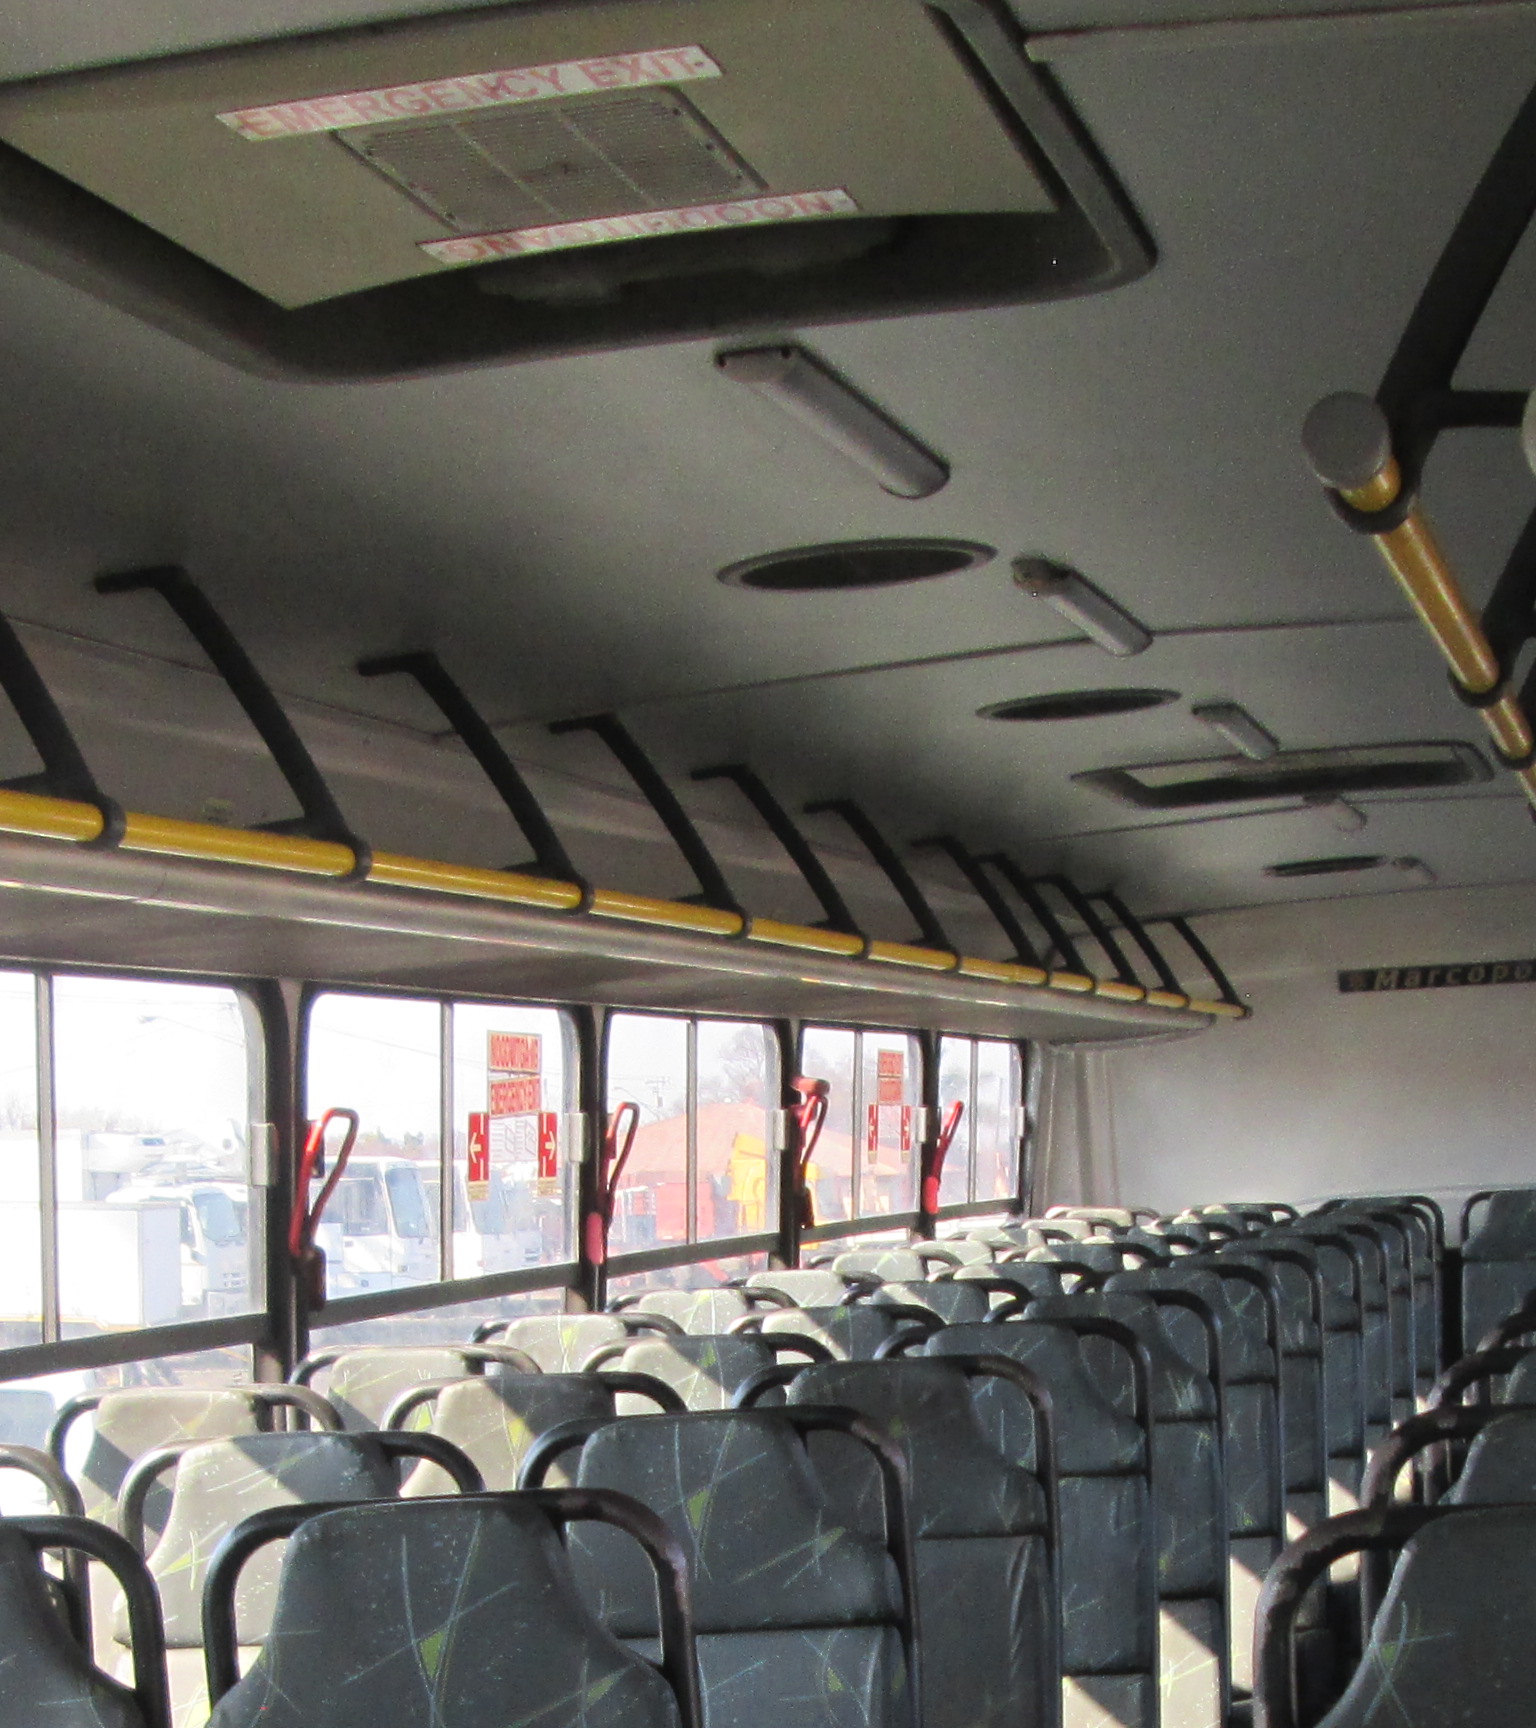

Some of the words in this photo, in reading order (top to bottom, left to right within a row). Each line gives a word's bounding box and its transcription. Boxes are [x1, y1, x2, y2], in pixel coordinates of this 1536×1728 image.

[236, 66, 565, 136] EMERGENCY
[577, 50, 696, 88] EXIT
[445, 193, 833, 262] NOODUITGANG
